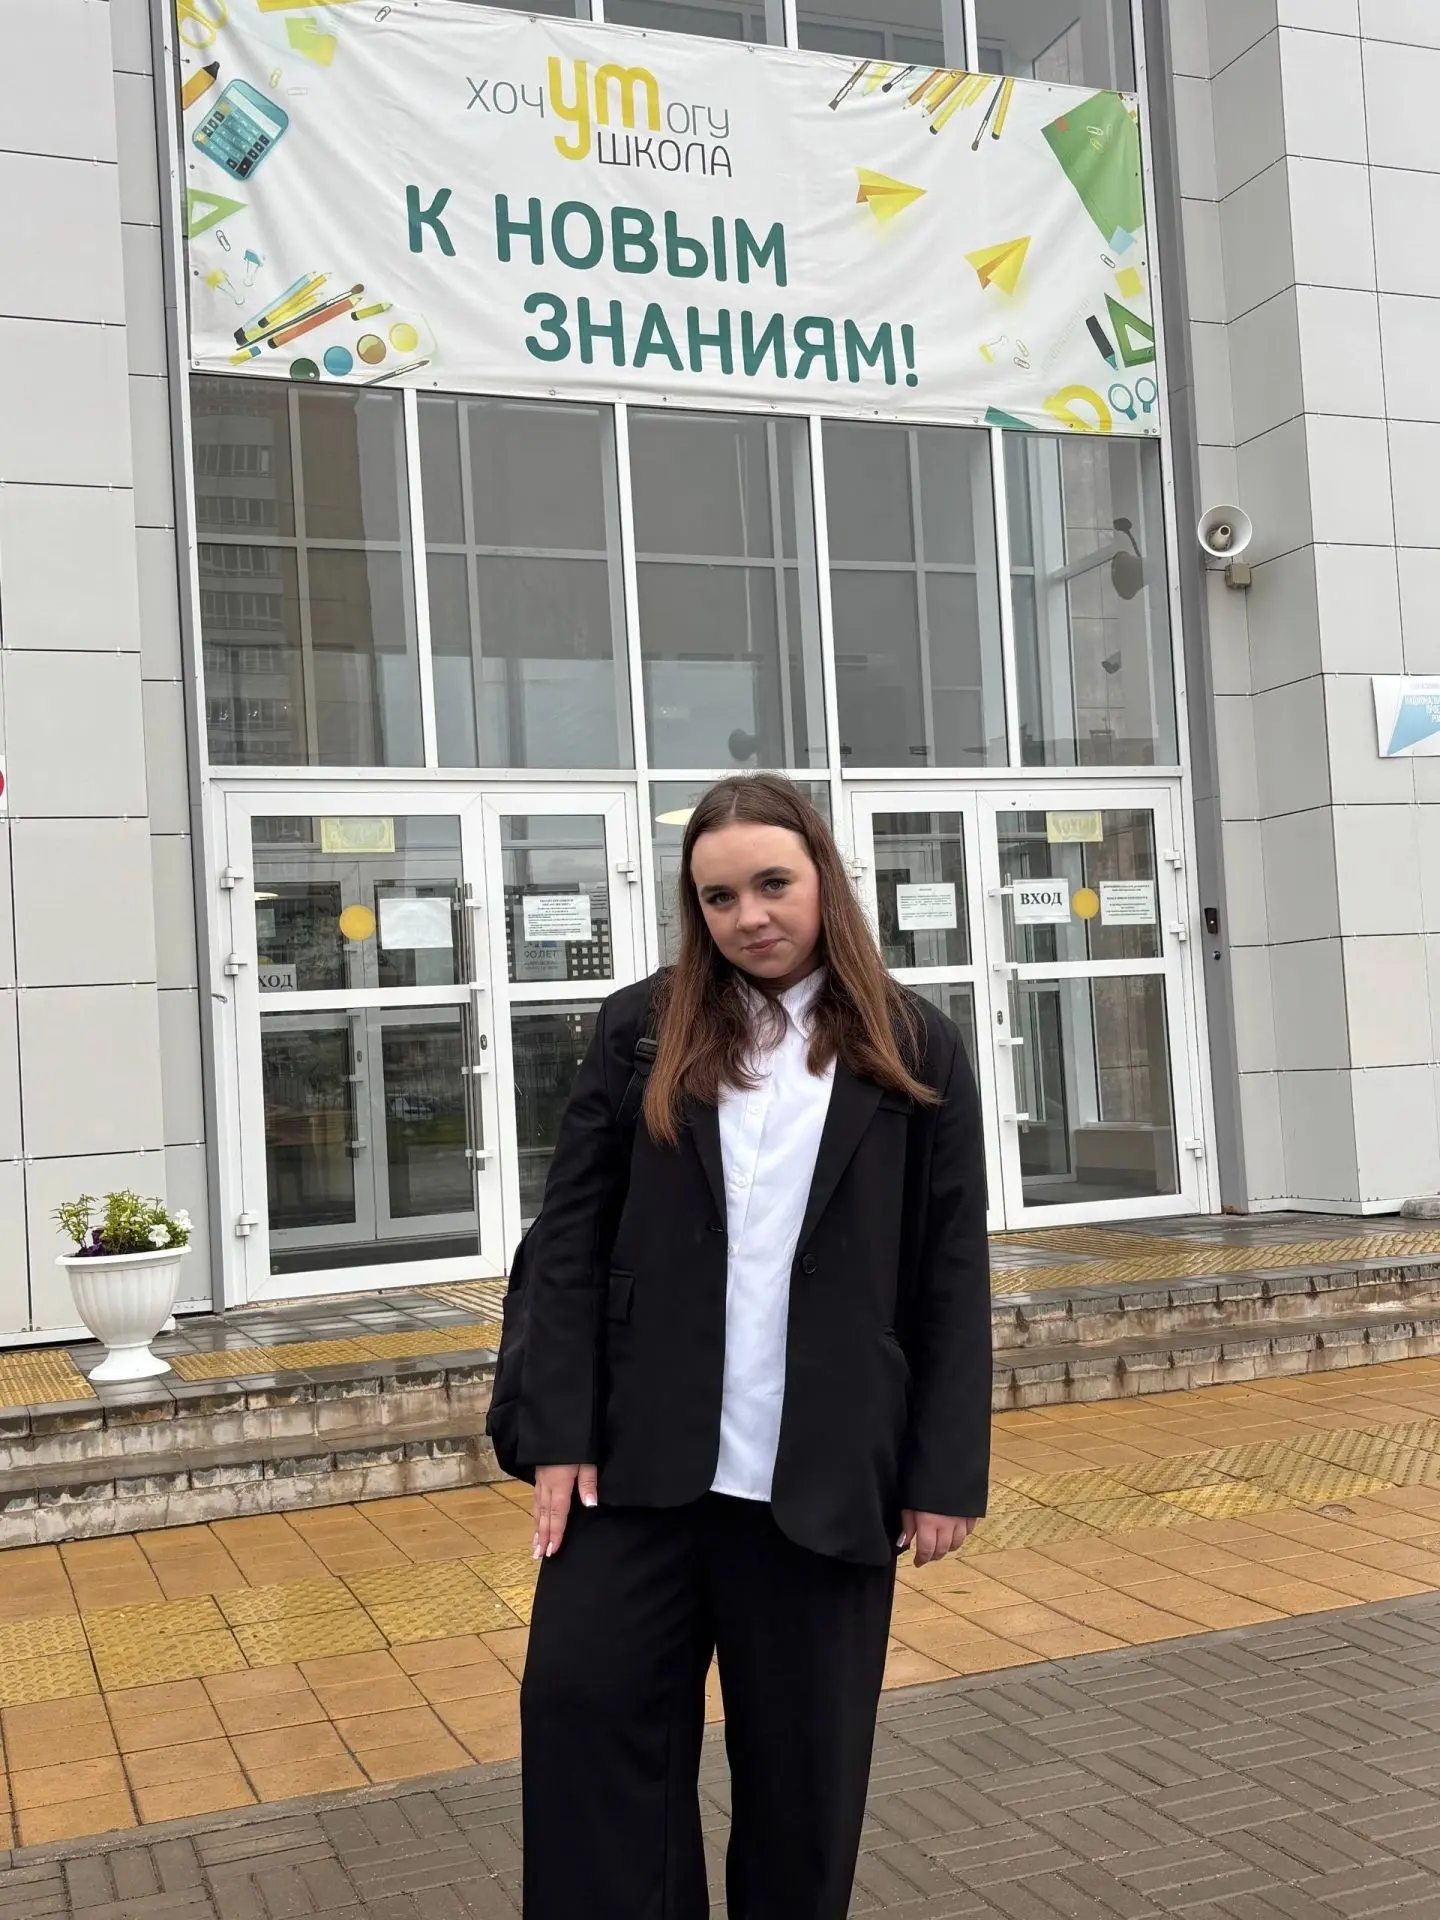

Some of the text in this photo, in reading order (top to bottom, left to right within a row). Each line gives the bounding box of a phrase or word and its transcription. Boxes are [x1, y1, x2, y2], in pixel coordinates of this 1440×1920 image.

[597, 131, 732, 178] ШКОЛА
[405, 184, 788, 287] К НОВЫМ
[523, 292, 919, 388] ЗНАНИЯМ!
[1020, 892, 1063, 906] ВХОД
